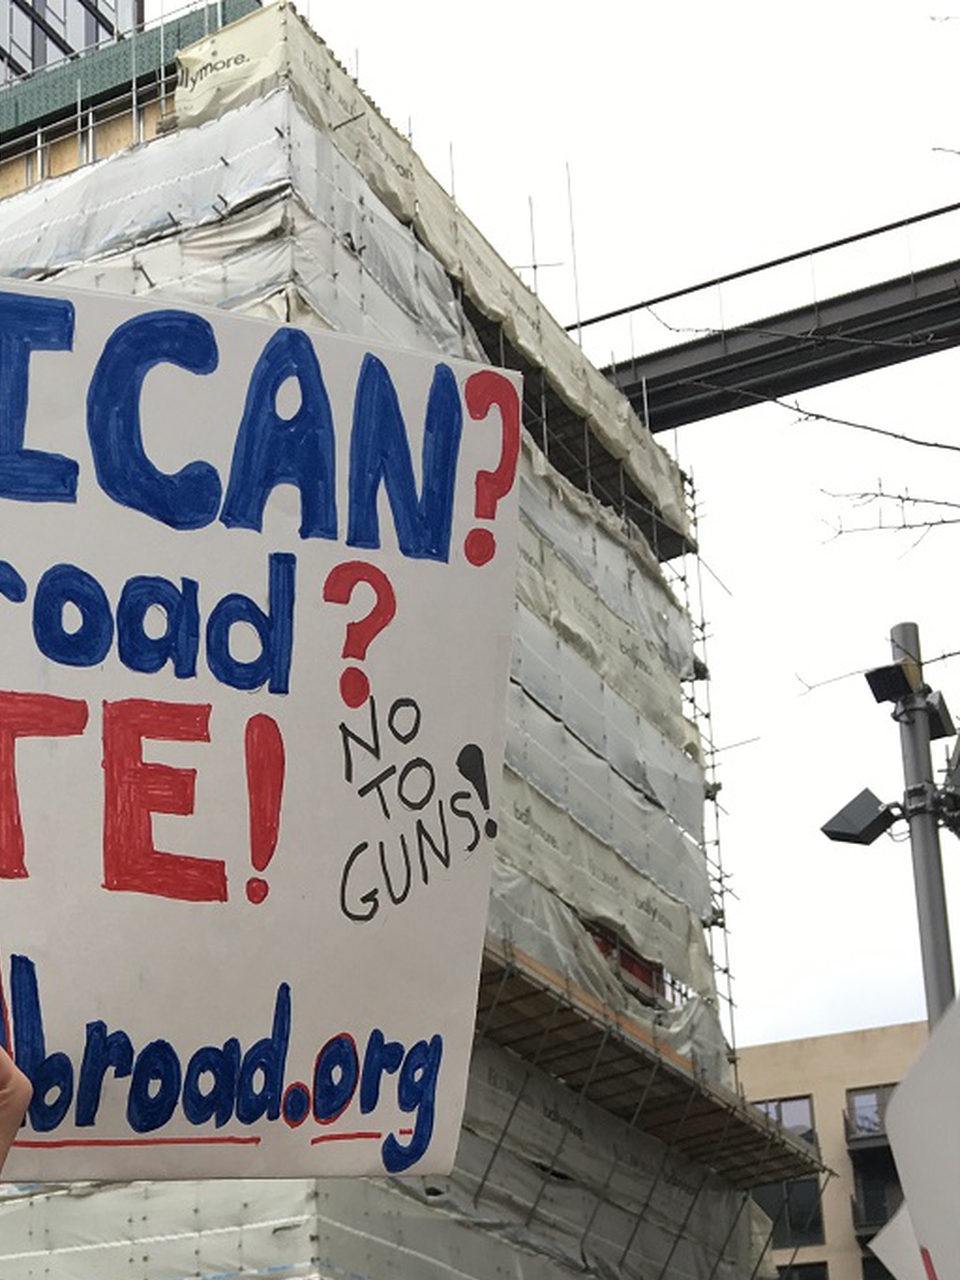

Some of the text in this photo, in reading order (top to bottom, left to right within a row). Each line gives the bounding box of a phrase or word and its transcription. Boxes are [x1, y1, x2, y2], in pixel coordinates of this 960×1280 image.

[339, 695, 421, 784] NO
[341, 744, 498, 921] GUNS!
[358, 757, 435, 820] TO
